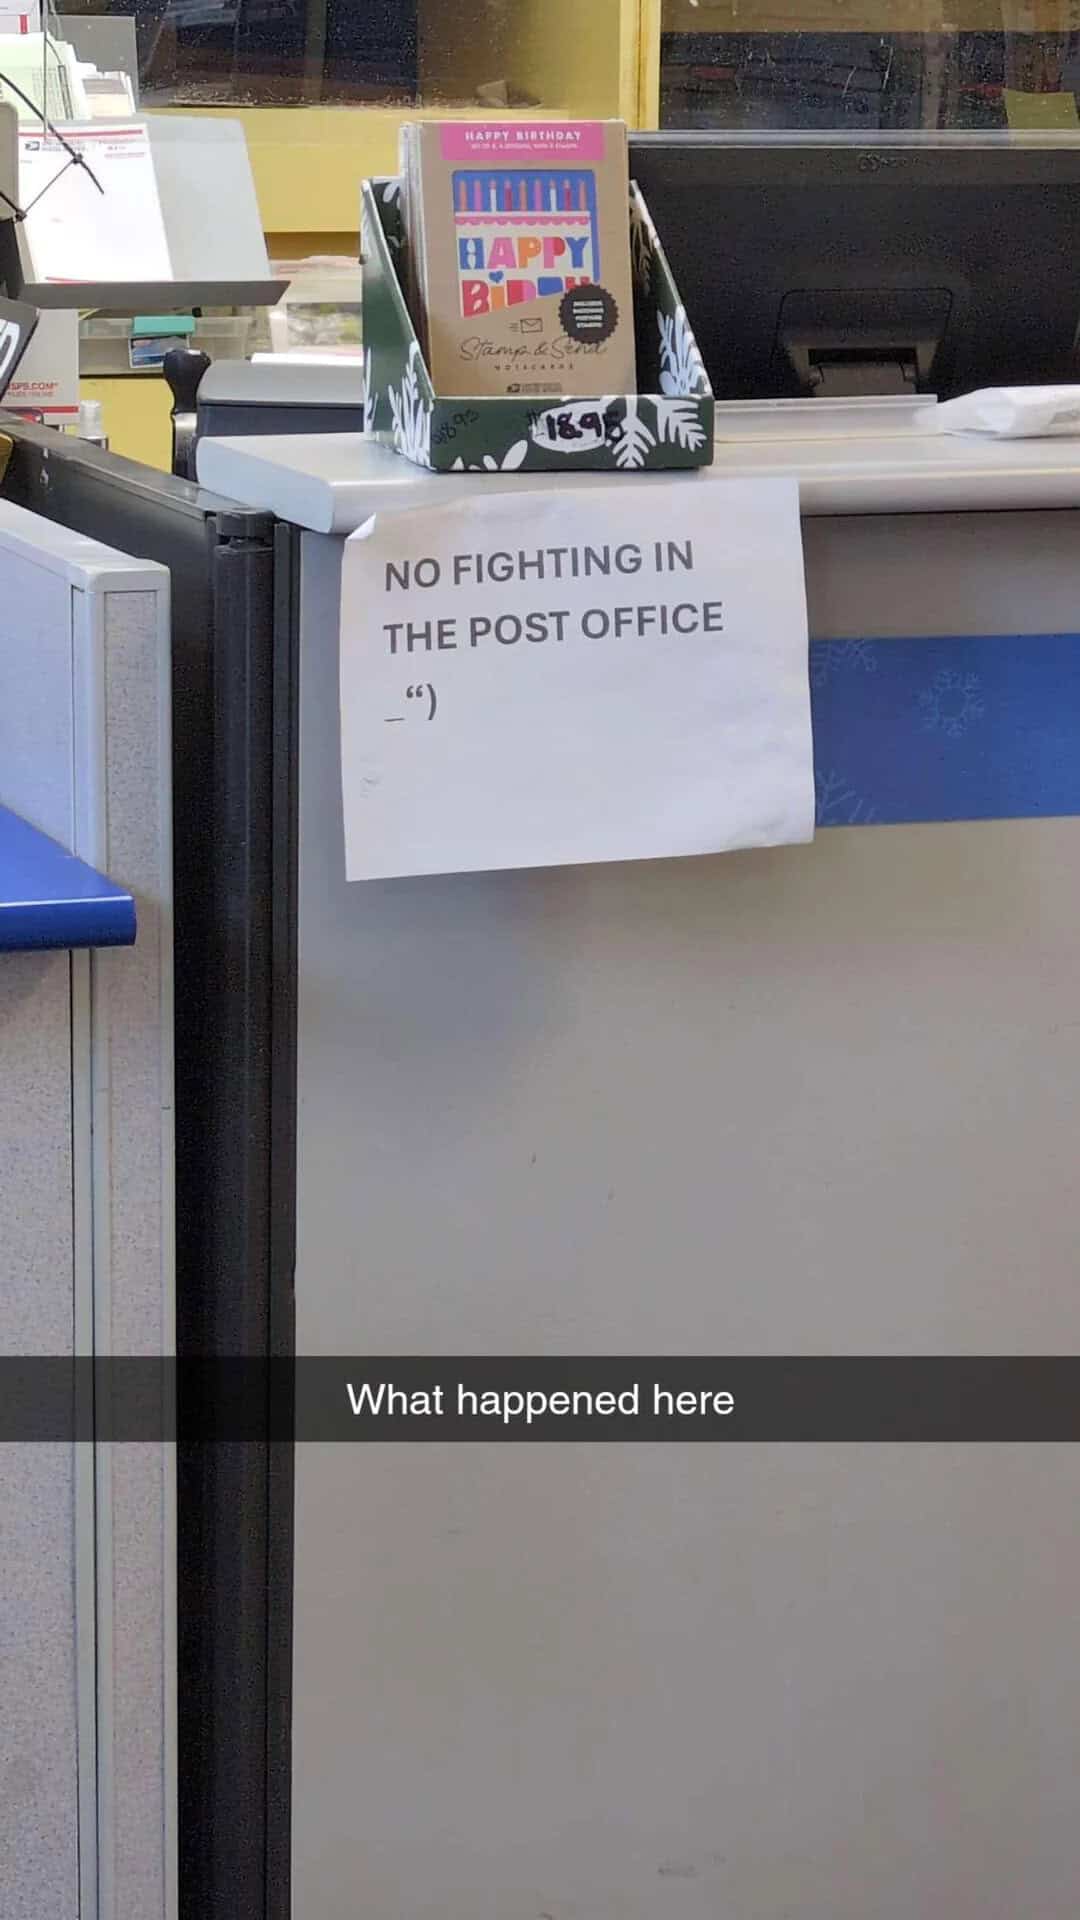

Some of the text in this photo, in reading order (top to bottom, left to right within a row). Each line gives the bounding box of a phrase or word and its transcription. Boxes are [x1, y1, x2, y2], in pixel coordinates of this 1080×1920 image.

[465, 130, 581, 141] HAPPY BIRTHDAY
[458, 236, 589, 270] HAPPY
[459, 336, 608, 361] Stamp & Send
[385, 540, 693, 592] NO FIGHTING IN
[383, 601, 723, 654] THE POST OFFICE
